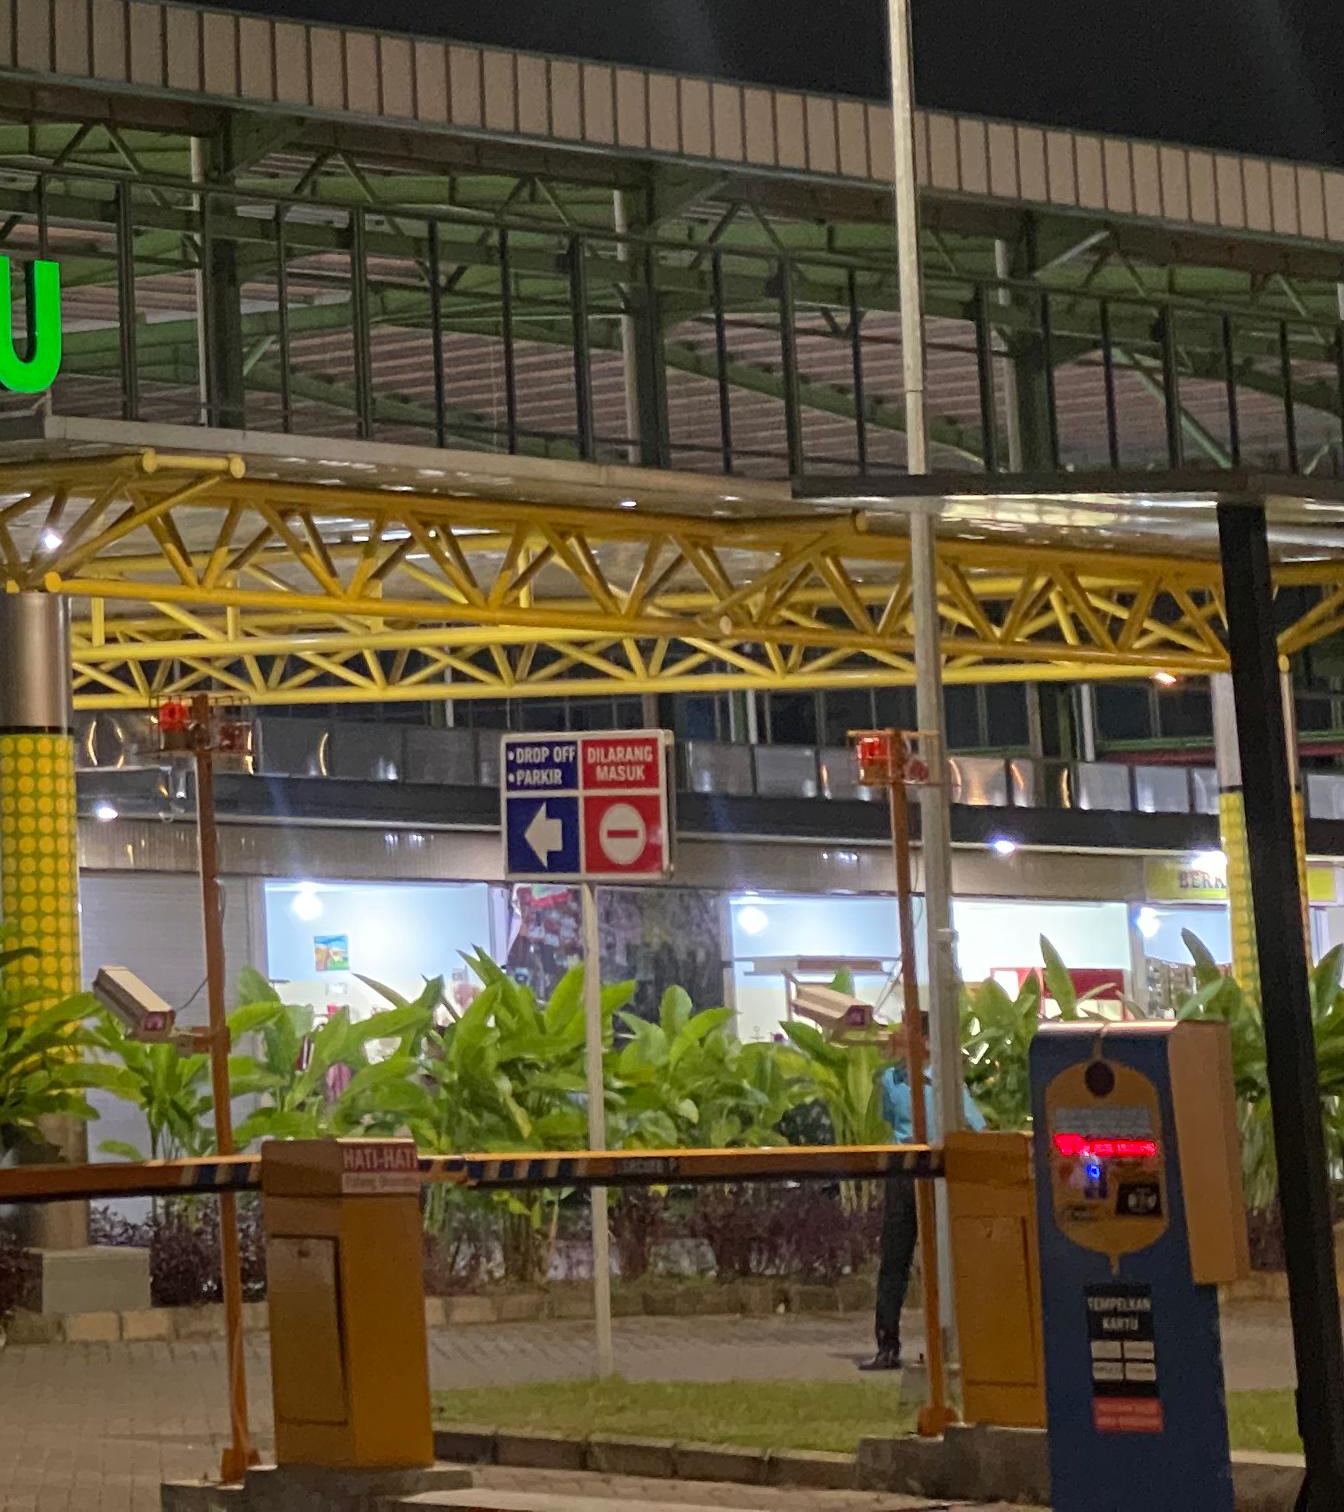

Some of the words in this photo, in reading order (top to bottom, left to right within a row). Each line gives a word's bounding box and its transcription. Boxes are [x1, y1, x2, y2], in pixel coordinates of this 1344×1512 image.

[516, 746, 550, 764] DROP
[553, 745, 576, 762] OFF
[587, 745, 653, 764] DILARANG
[516, 768, 562, 785] PARKIR
[596, 764, 646, 782] MASUK
[343, 1148, 417, 1169] HATI-HATI
